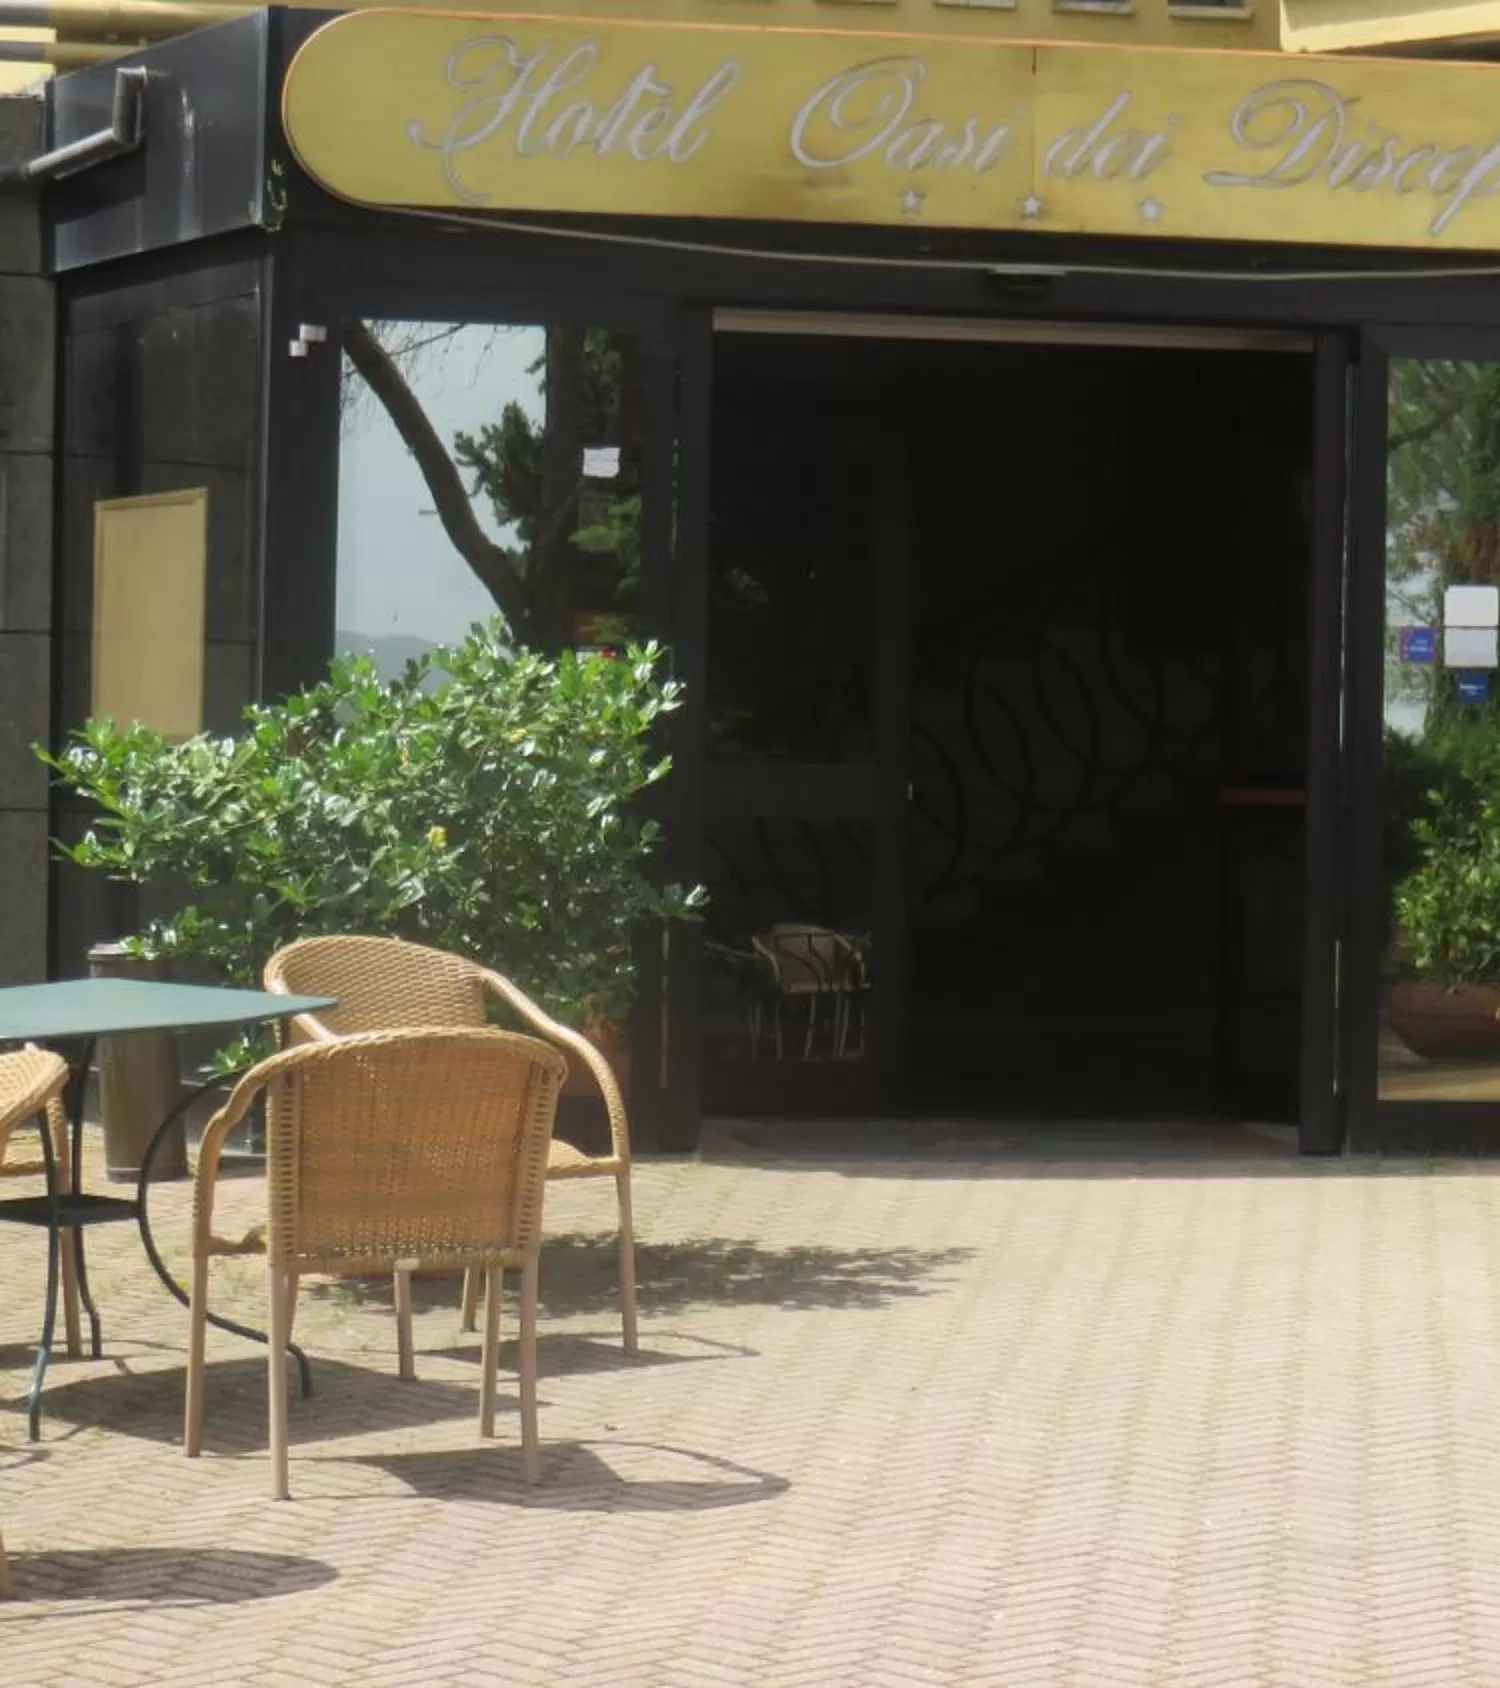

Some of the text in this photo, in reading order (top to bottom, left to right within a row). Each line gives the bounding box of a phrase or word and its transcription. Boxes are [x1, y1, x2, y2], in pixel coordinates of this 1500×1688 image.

[408, 35, 740, 204] Hotel
[789, 54, 1022, 177] Oasi
[1043, 89, 1179, 182] dei
